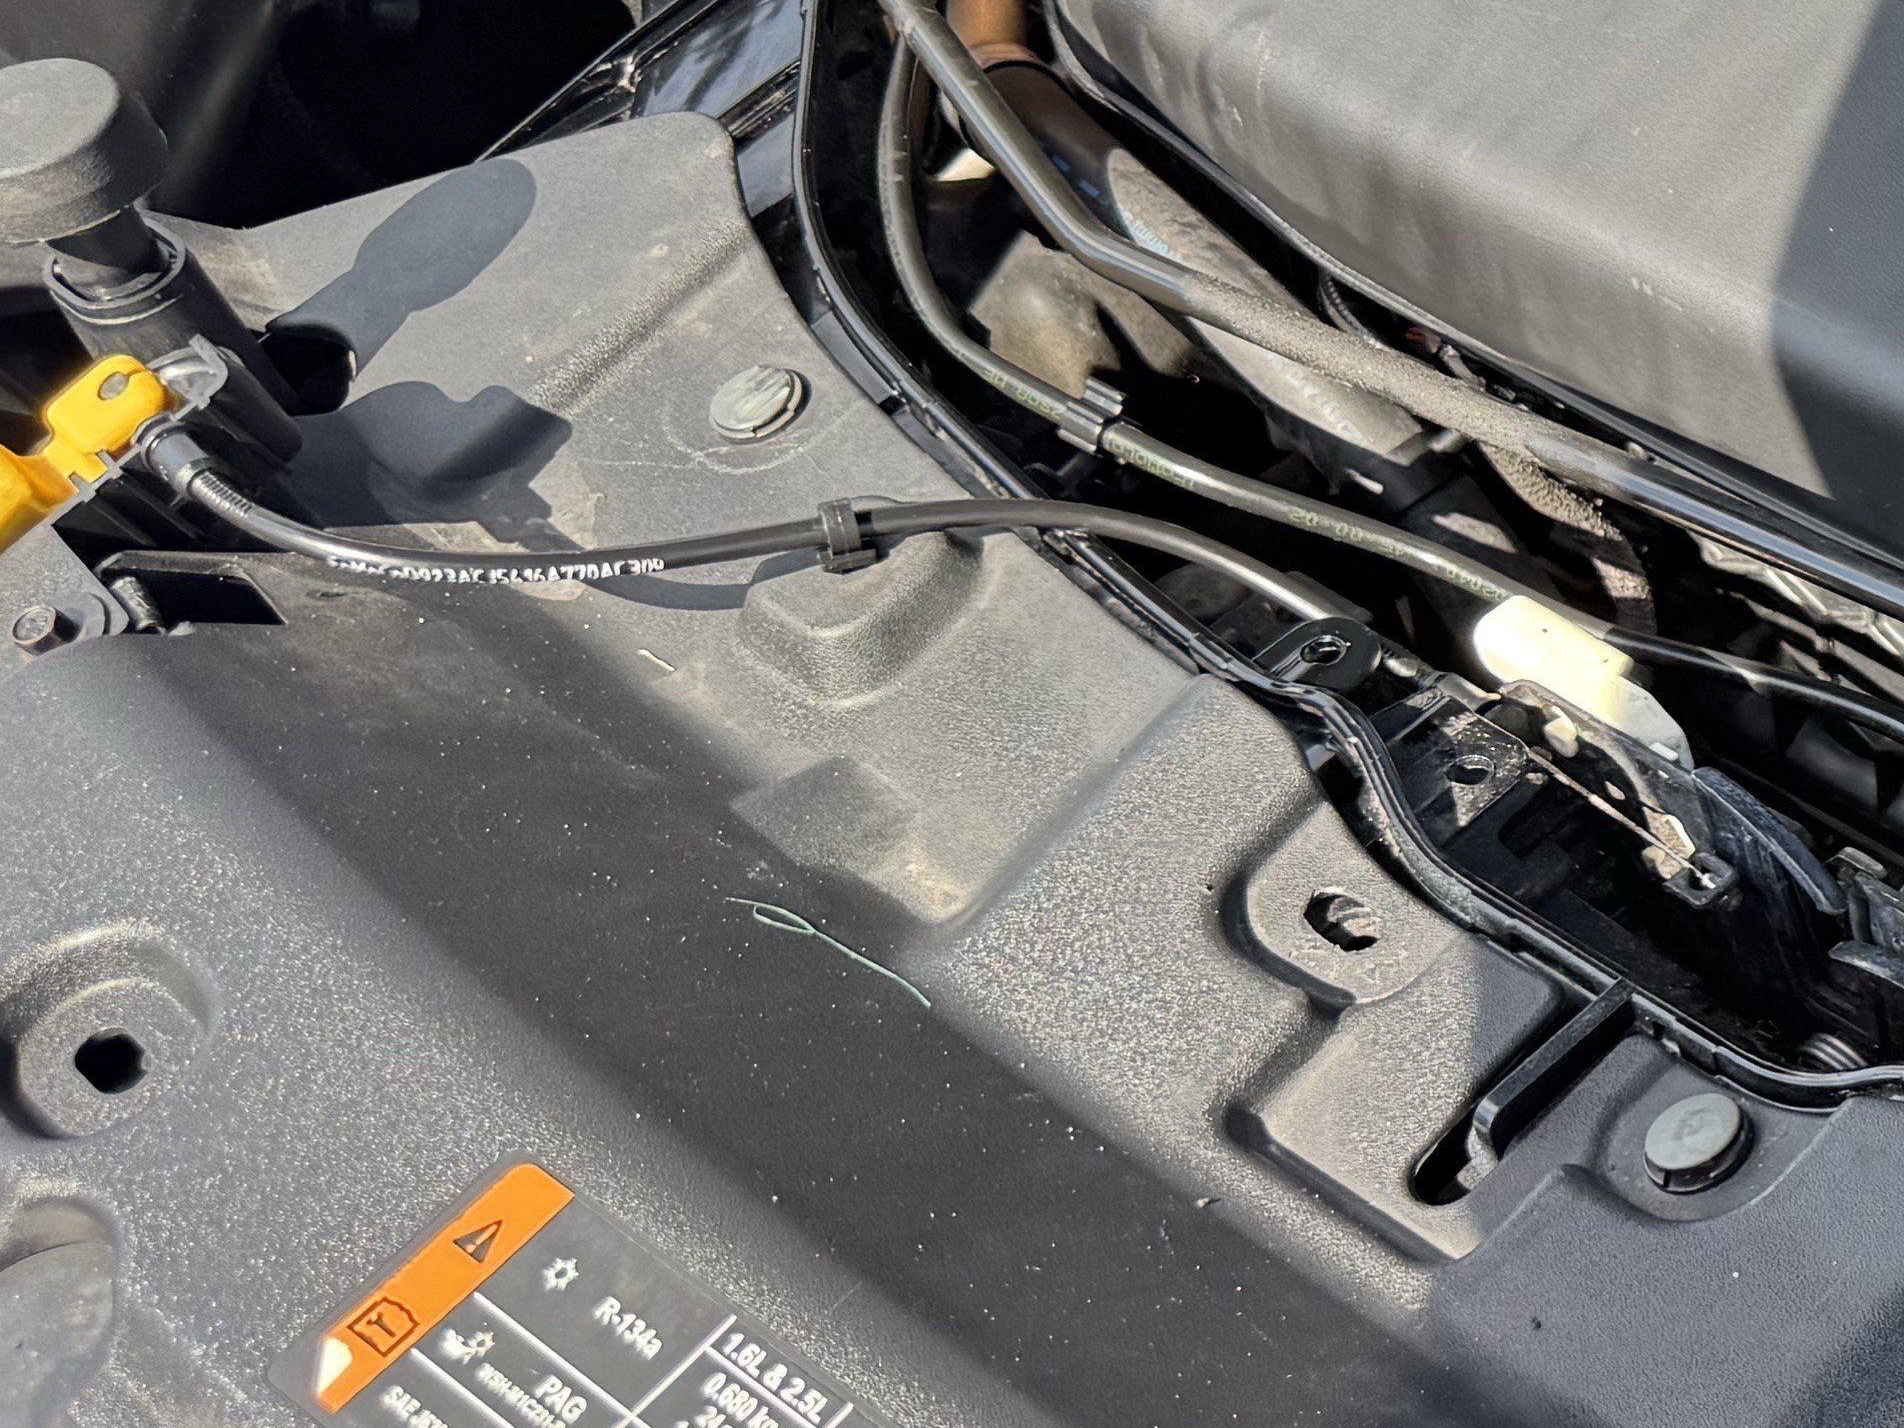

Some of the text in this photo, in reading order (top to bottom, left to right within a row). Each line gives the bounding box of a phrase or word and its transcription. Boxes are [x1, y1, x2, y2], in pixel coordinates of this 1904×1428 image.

[591, 1295, 662, 1360] R-134a
[533, 1374, 587, 1424] PAG
[699, 1372, 758, 1422] 0.680
[721, 1332, 828, 1424] 1.6L & 2.5L
[379, 1385, 420, 1422] SAE
